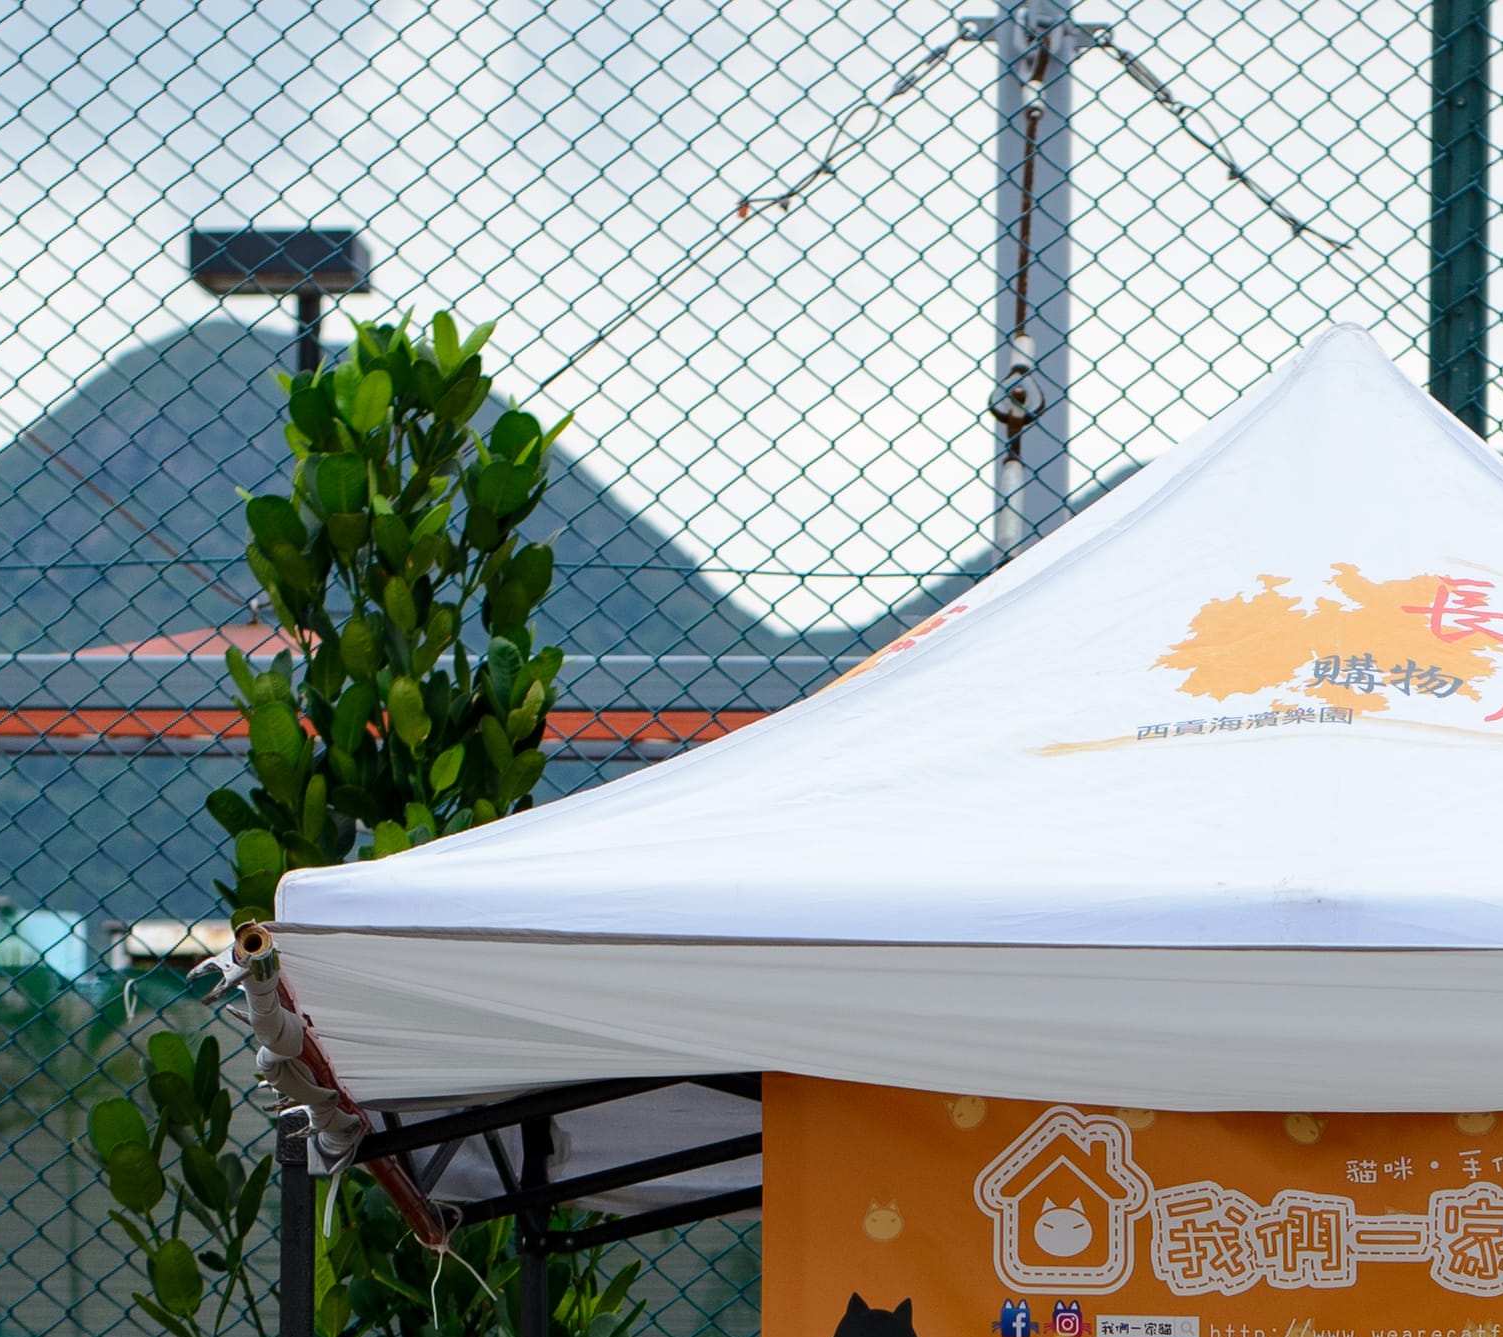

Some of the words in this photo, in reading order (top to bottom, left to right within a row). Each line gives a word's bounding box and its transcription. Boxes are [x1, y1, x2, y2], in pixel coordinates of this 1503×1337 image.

[1313, 653, 1463, 699] 購物
[1136, 705, 1355, 741] 西貢海濱樂園
[1101, 1321, 1173, 1336] 我們一家貓
